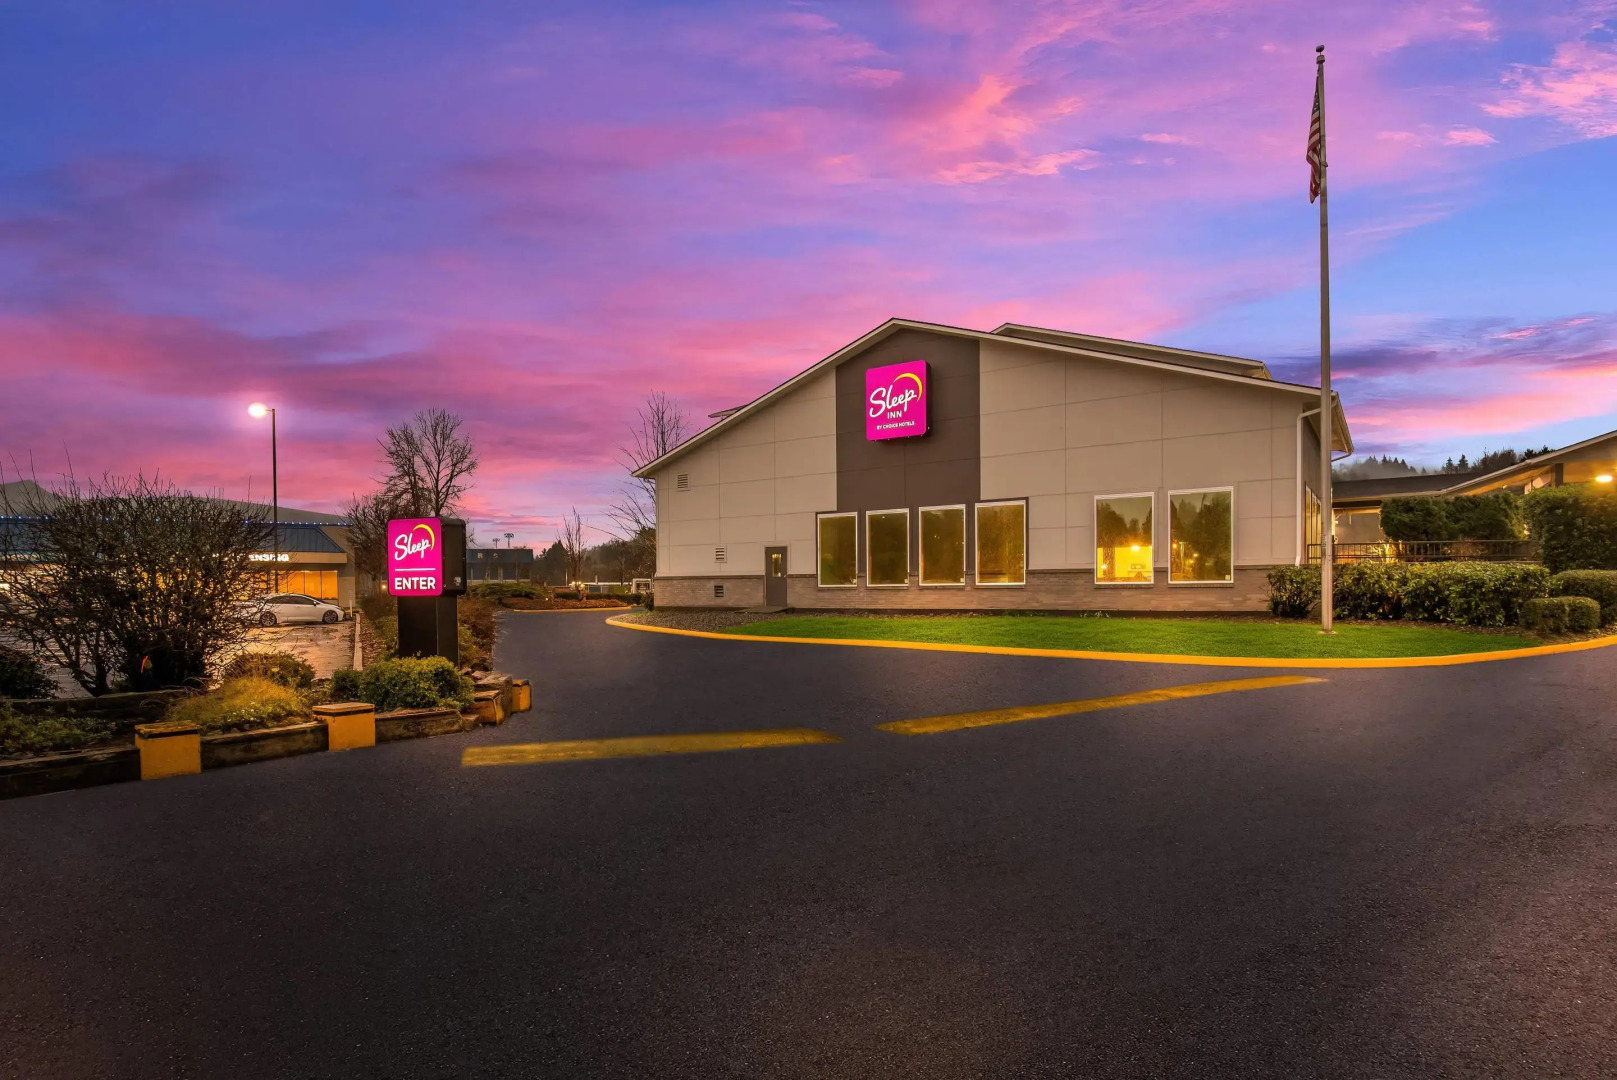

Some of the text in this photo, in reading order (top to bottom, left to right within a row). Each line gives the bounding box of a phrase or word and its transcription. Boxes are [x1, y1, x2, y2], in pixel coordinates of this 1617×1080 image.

[869, 385, 917, 418] Sleep
[887, 411, 902, 419] INN
[394, 532, 432, 561] Sleep
[394, 576, 436, 590] ENTER
